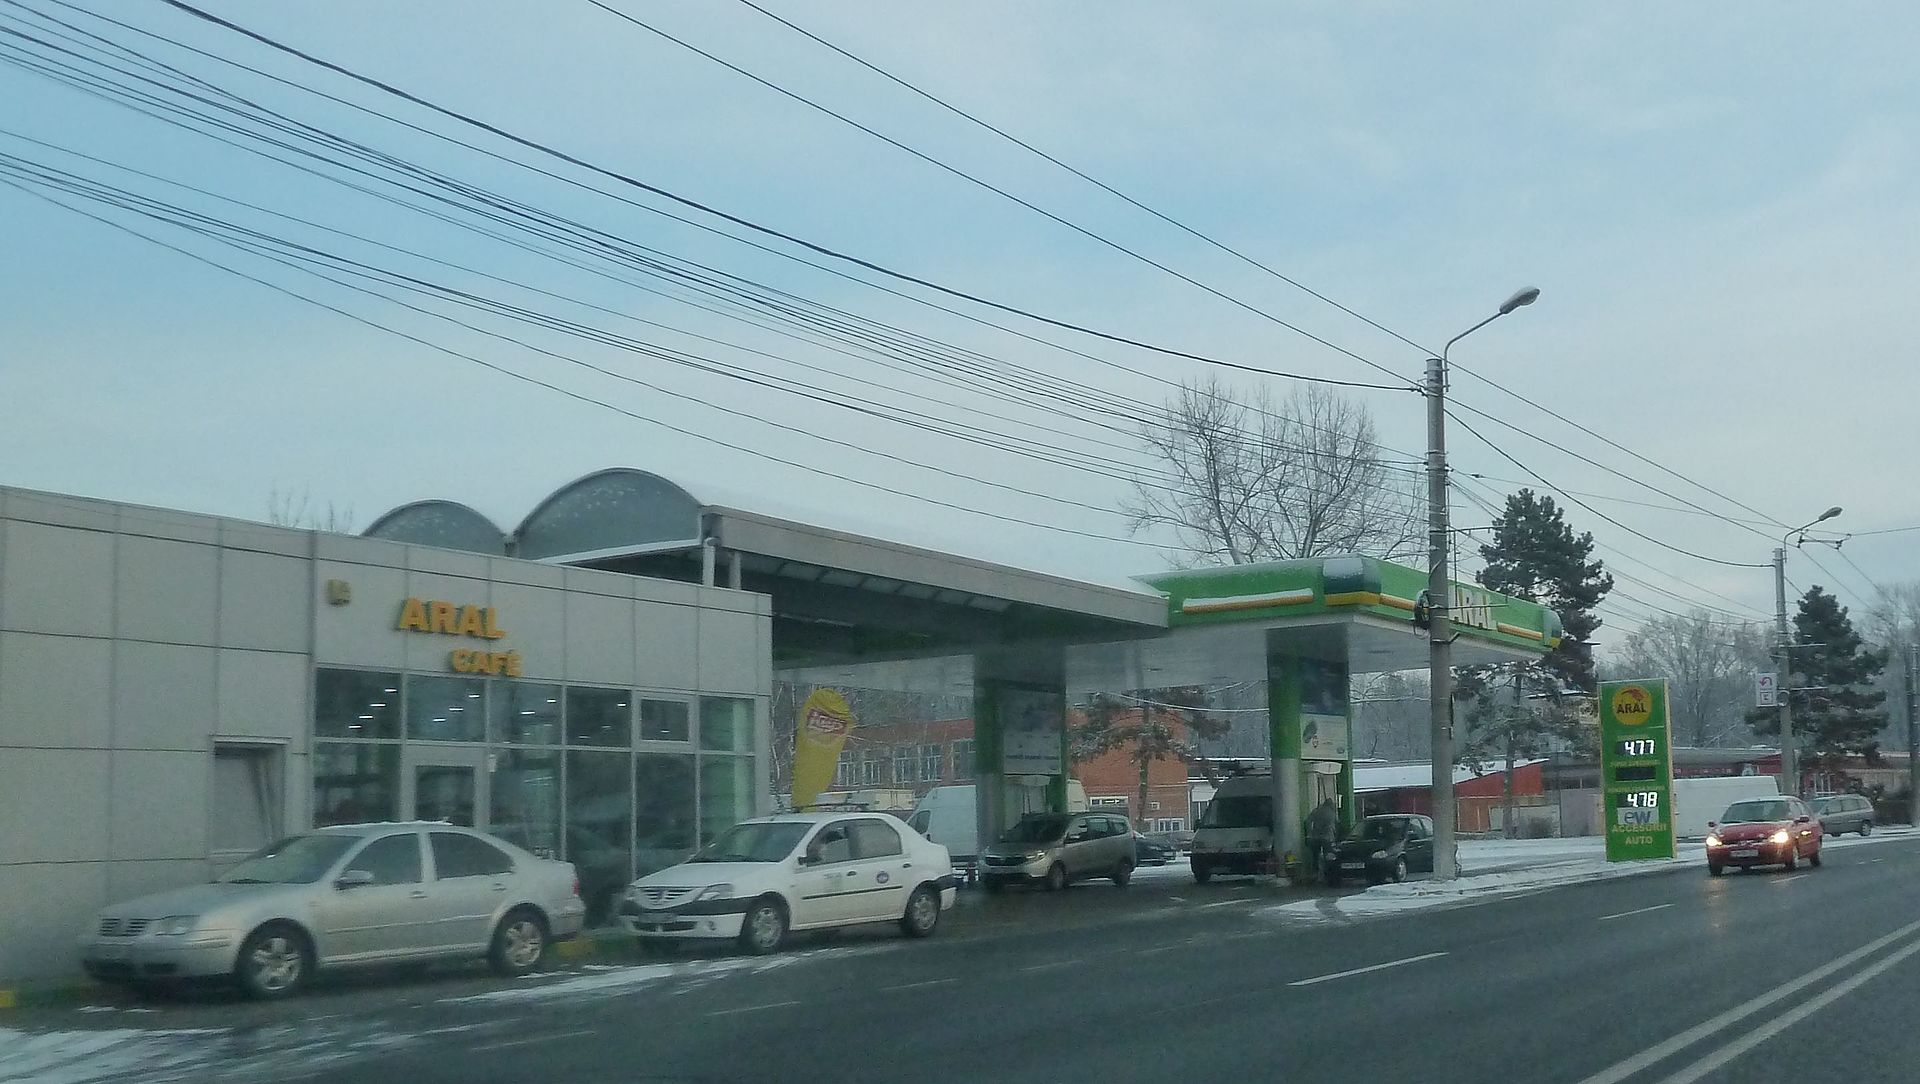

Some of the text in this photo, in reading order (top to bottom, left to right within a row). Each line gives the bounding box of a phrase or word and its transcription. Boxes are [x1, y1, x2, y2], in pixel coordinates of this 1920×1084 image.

[399, 598, 506, 638] ARAL
[1616, 703, 1647, 714] ARAL
[1625, 836, 1654, 845] AUTO
